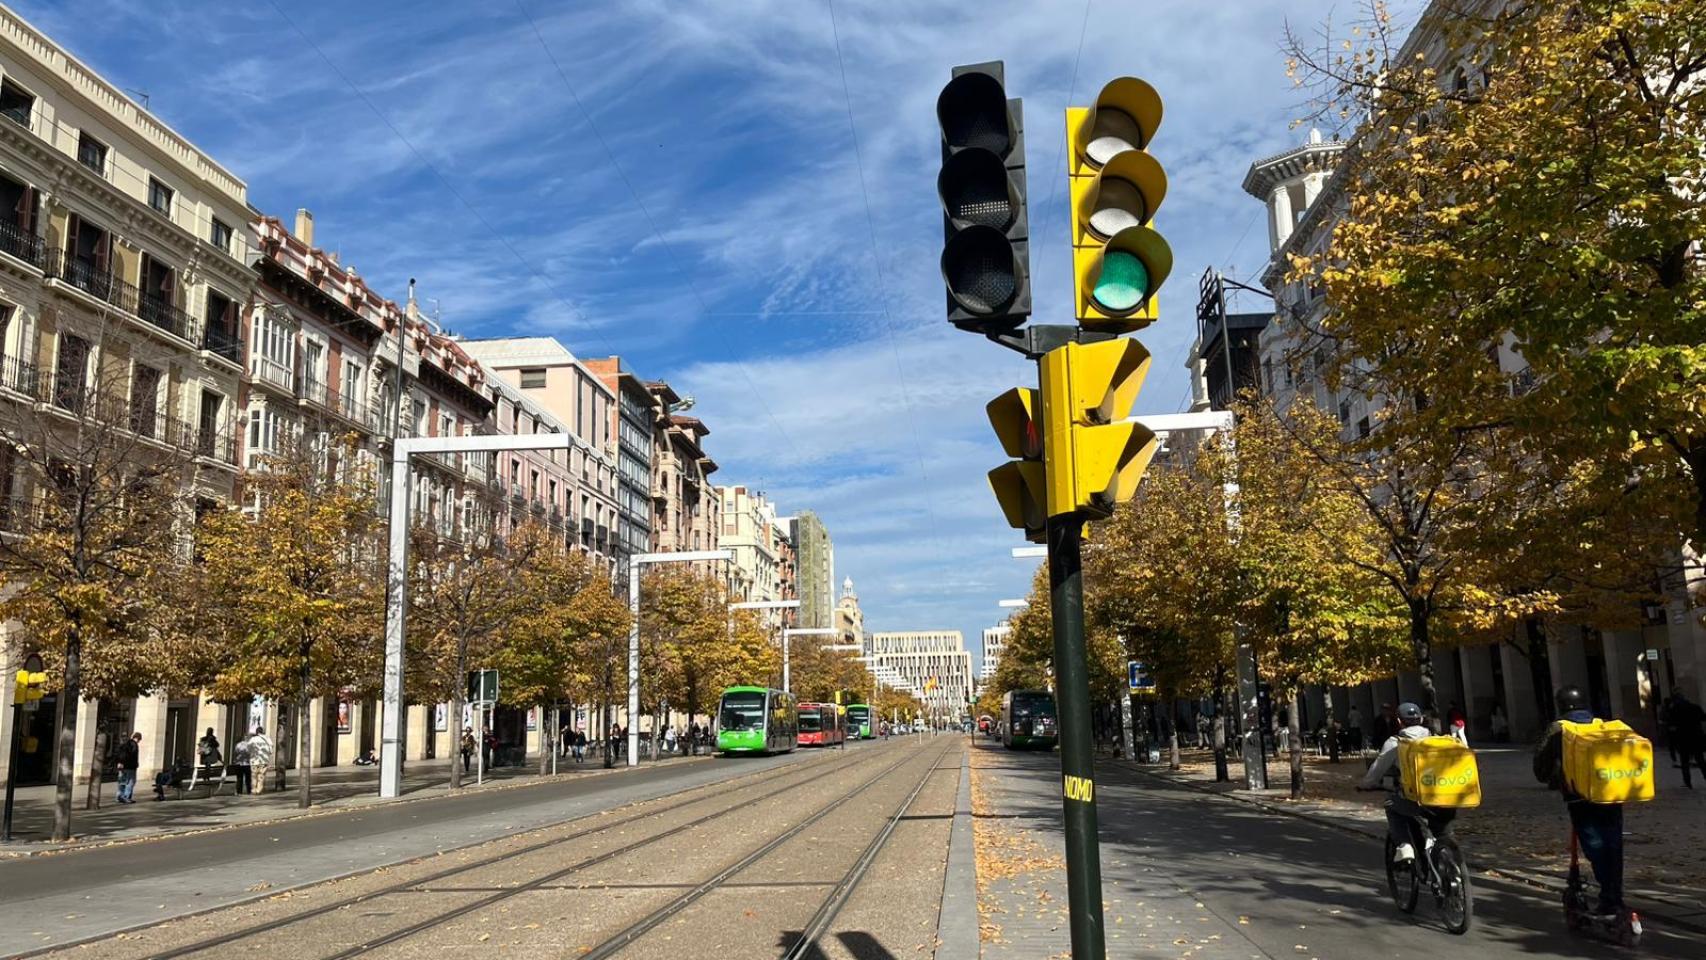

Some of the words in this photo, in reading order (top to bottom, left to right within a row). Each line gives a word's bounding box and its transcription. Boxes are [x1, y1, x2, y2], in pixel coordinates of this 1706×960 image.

[1421, 771, 1470, 787] Glovo
[1596, 763, 1647, 780] Glovo
[1064, 775, 1092, 802] NOMO
